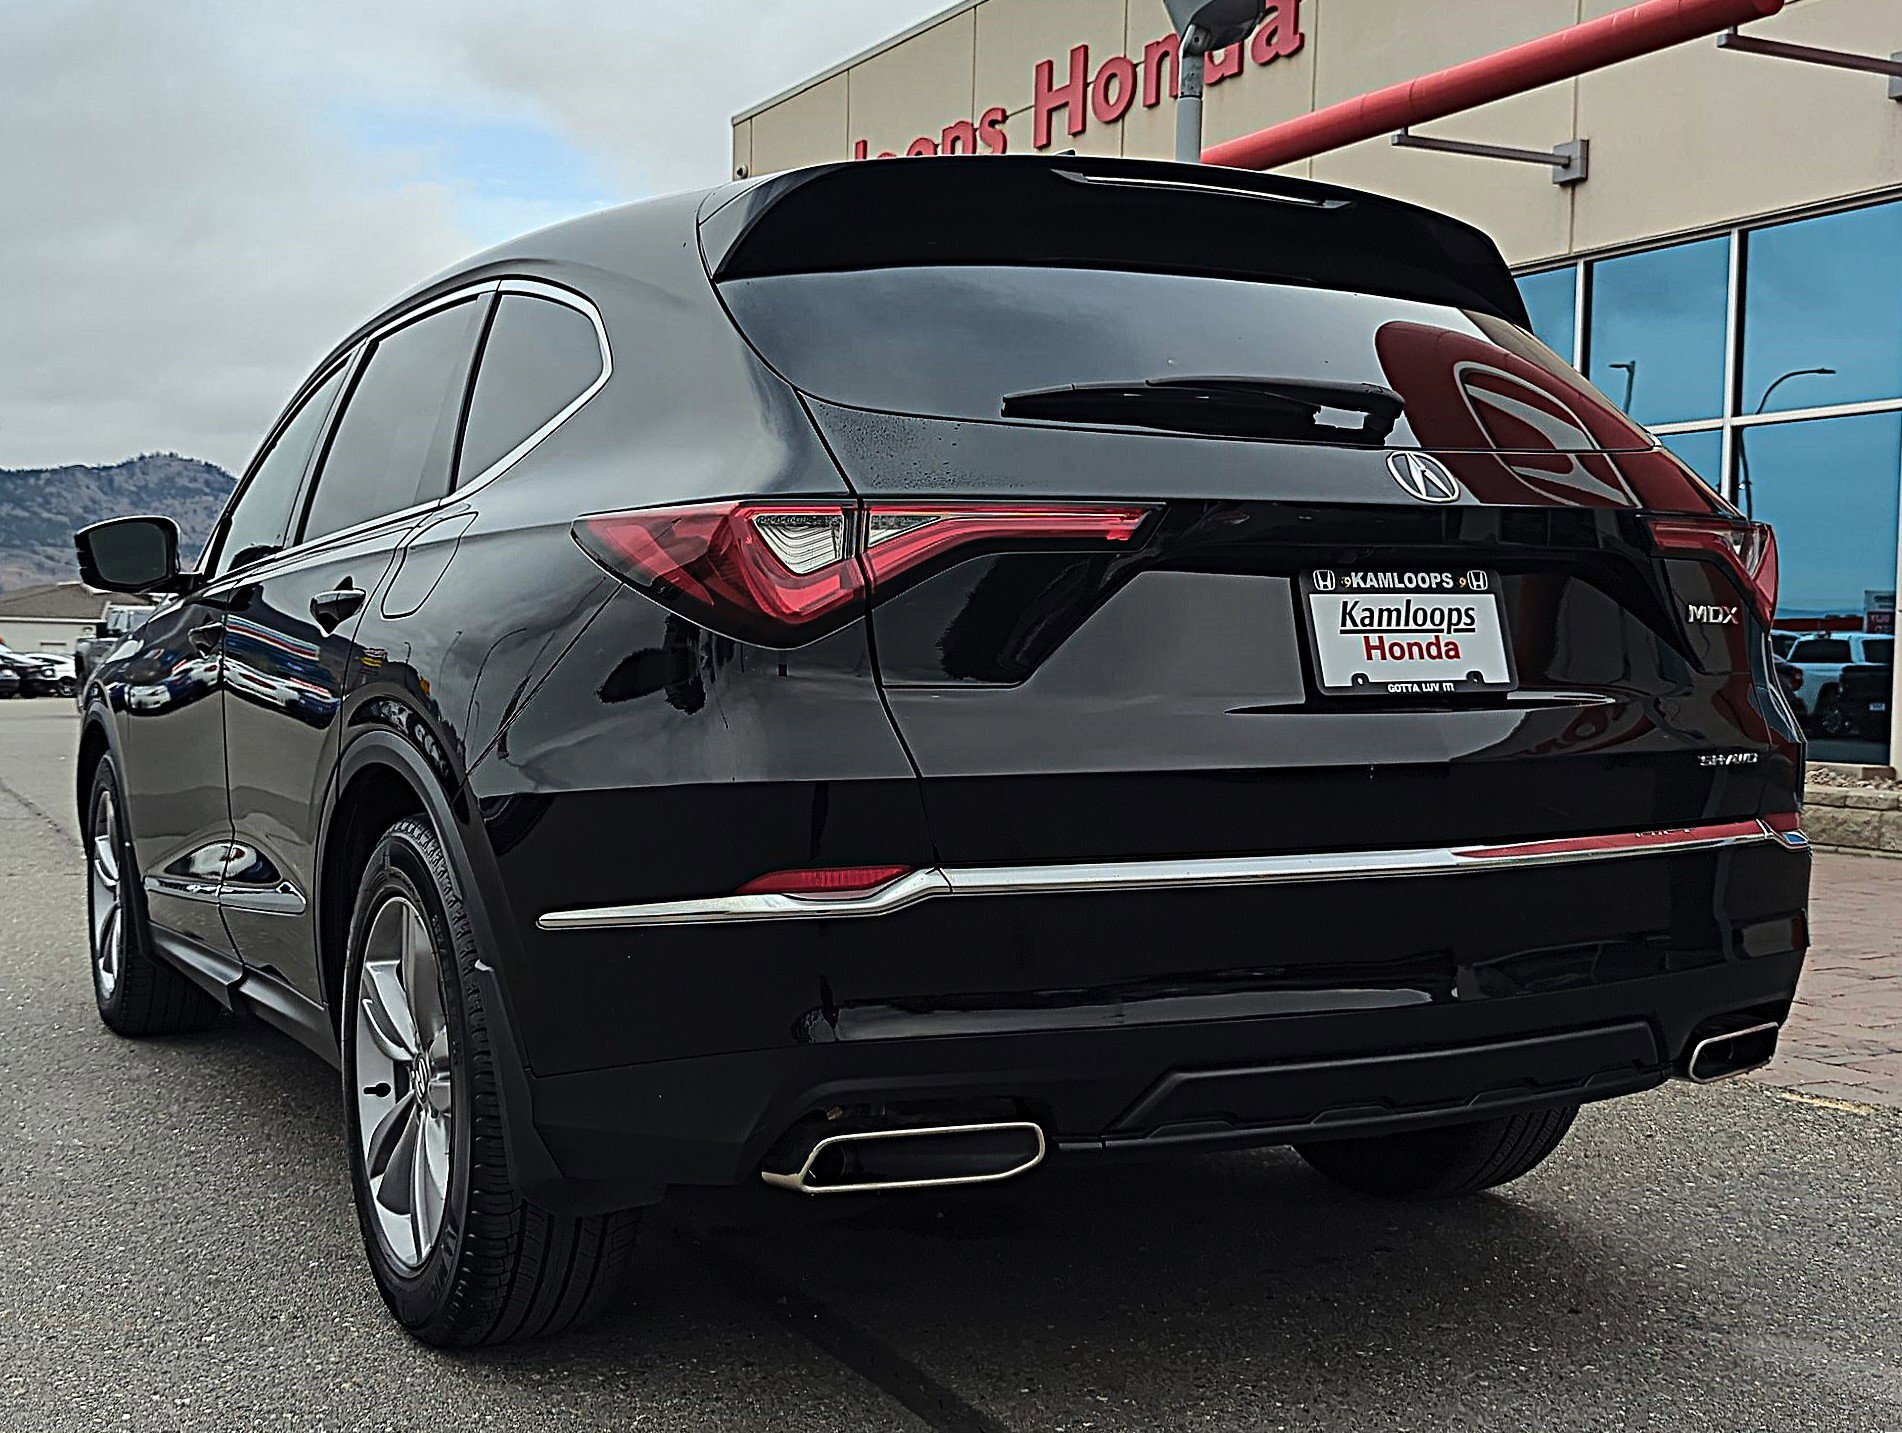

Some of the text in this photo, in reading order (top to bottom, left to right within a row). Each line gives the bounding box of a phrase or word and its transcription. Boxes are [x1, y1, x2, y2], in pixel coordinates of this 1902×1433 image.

[1351, 572, 1454, 589] KAMLOOPS
[1340, 599, 1476, 635] Kamloops
[1688, 604, 1738, 623] MDX
[1364, 635, 1460, 660] Honda
[1387, 683, 1420, 693] GOTTA
[1421, 682, 1440, 692] LUV
